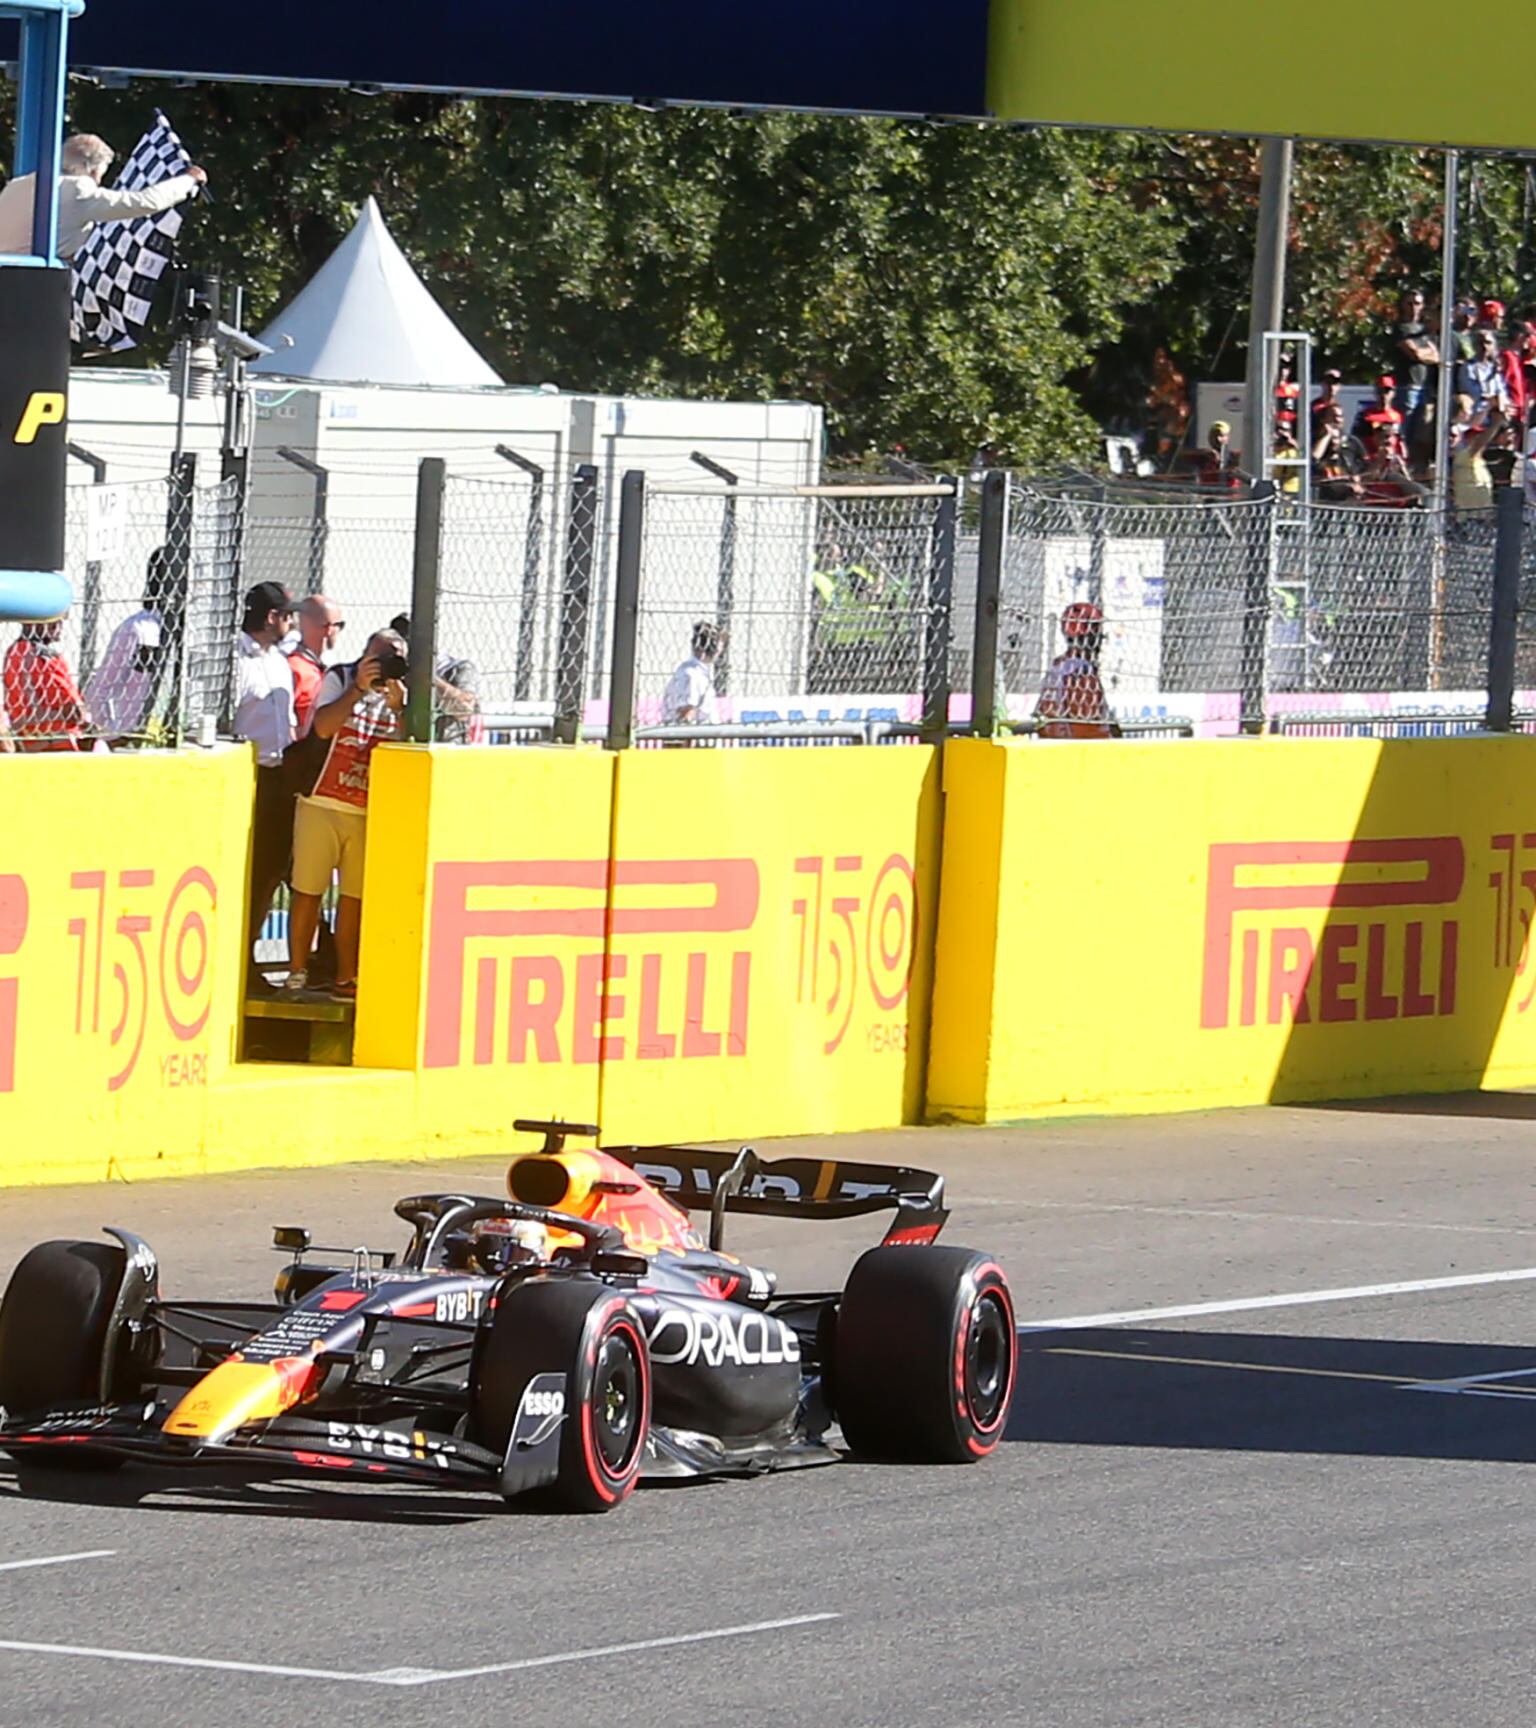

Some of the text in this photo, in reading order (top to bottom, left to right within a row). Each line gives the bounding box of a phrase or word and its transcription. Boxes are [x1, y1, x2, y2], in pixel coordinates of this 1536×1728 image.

[12, 391, 64, 443] P
[1199, 835, 1466, 1030] PIRELLI
[67, 865, 218, 1092] 150
[423, 853, 919, 1069] PIRELLI 150
[436, 1284, 483, 1322] BYBIT
[646, 1309, 802, 1367] ORACLE
[525, 1391, 565, 1416] ESSO
[327, 1421, 457, 1469] BYBIT
